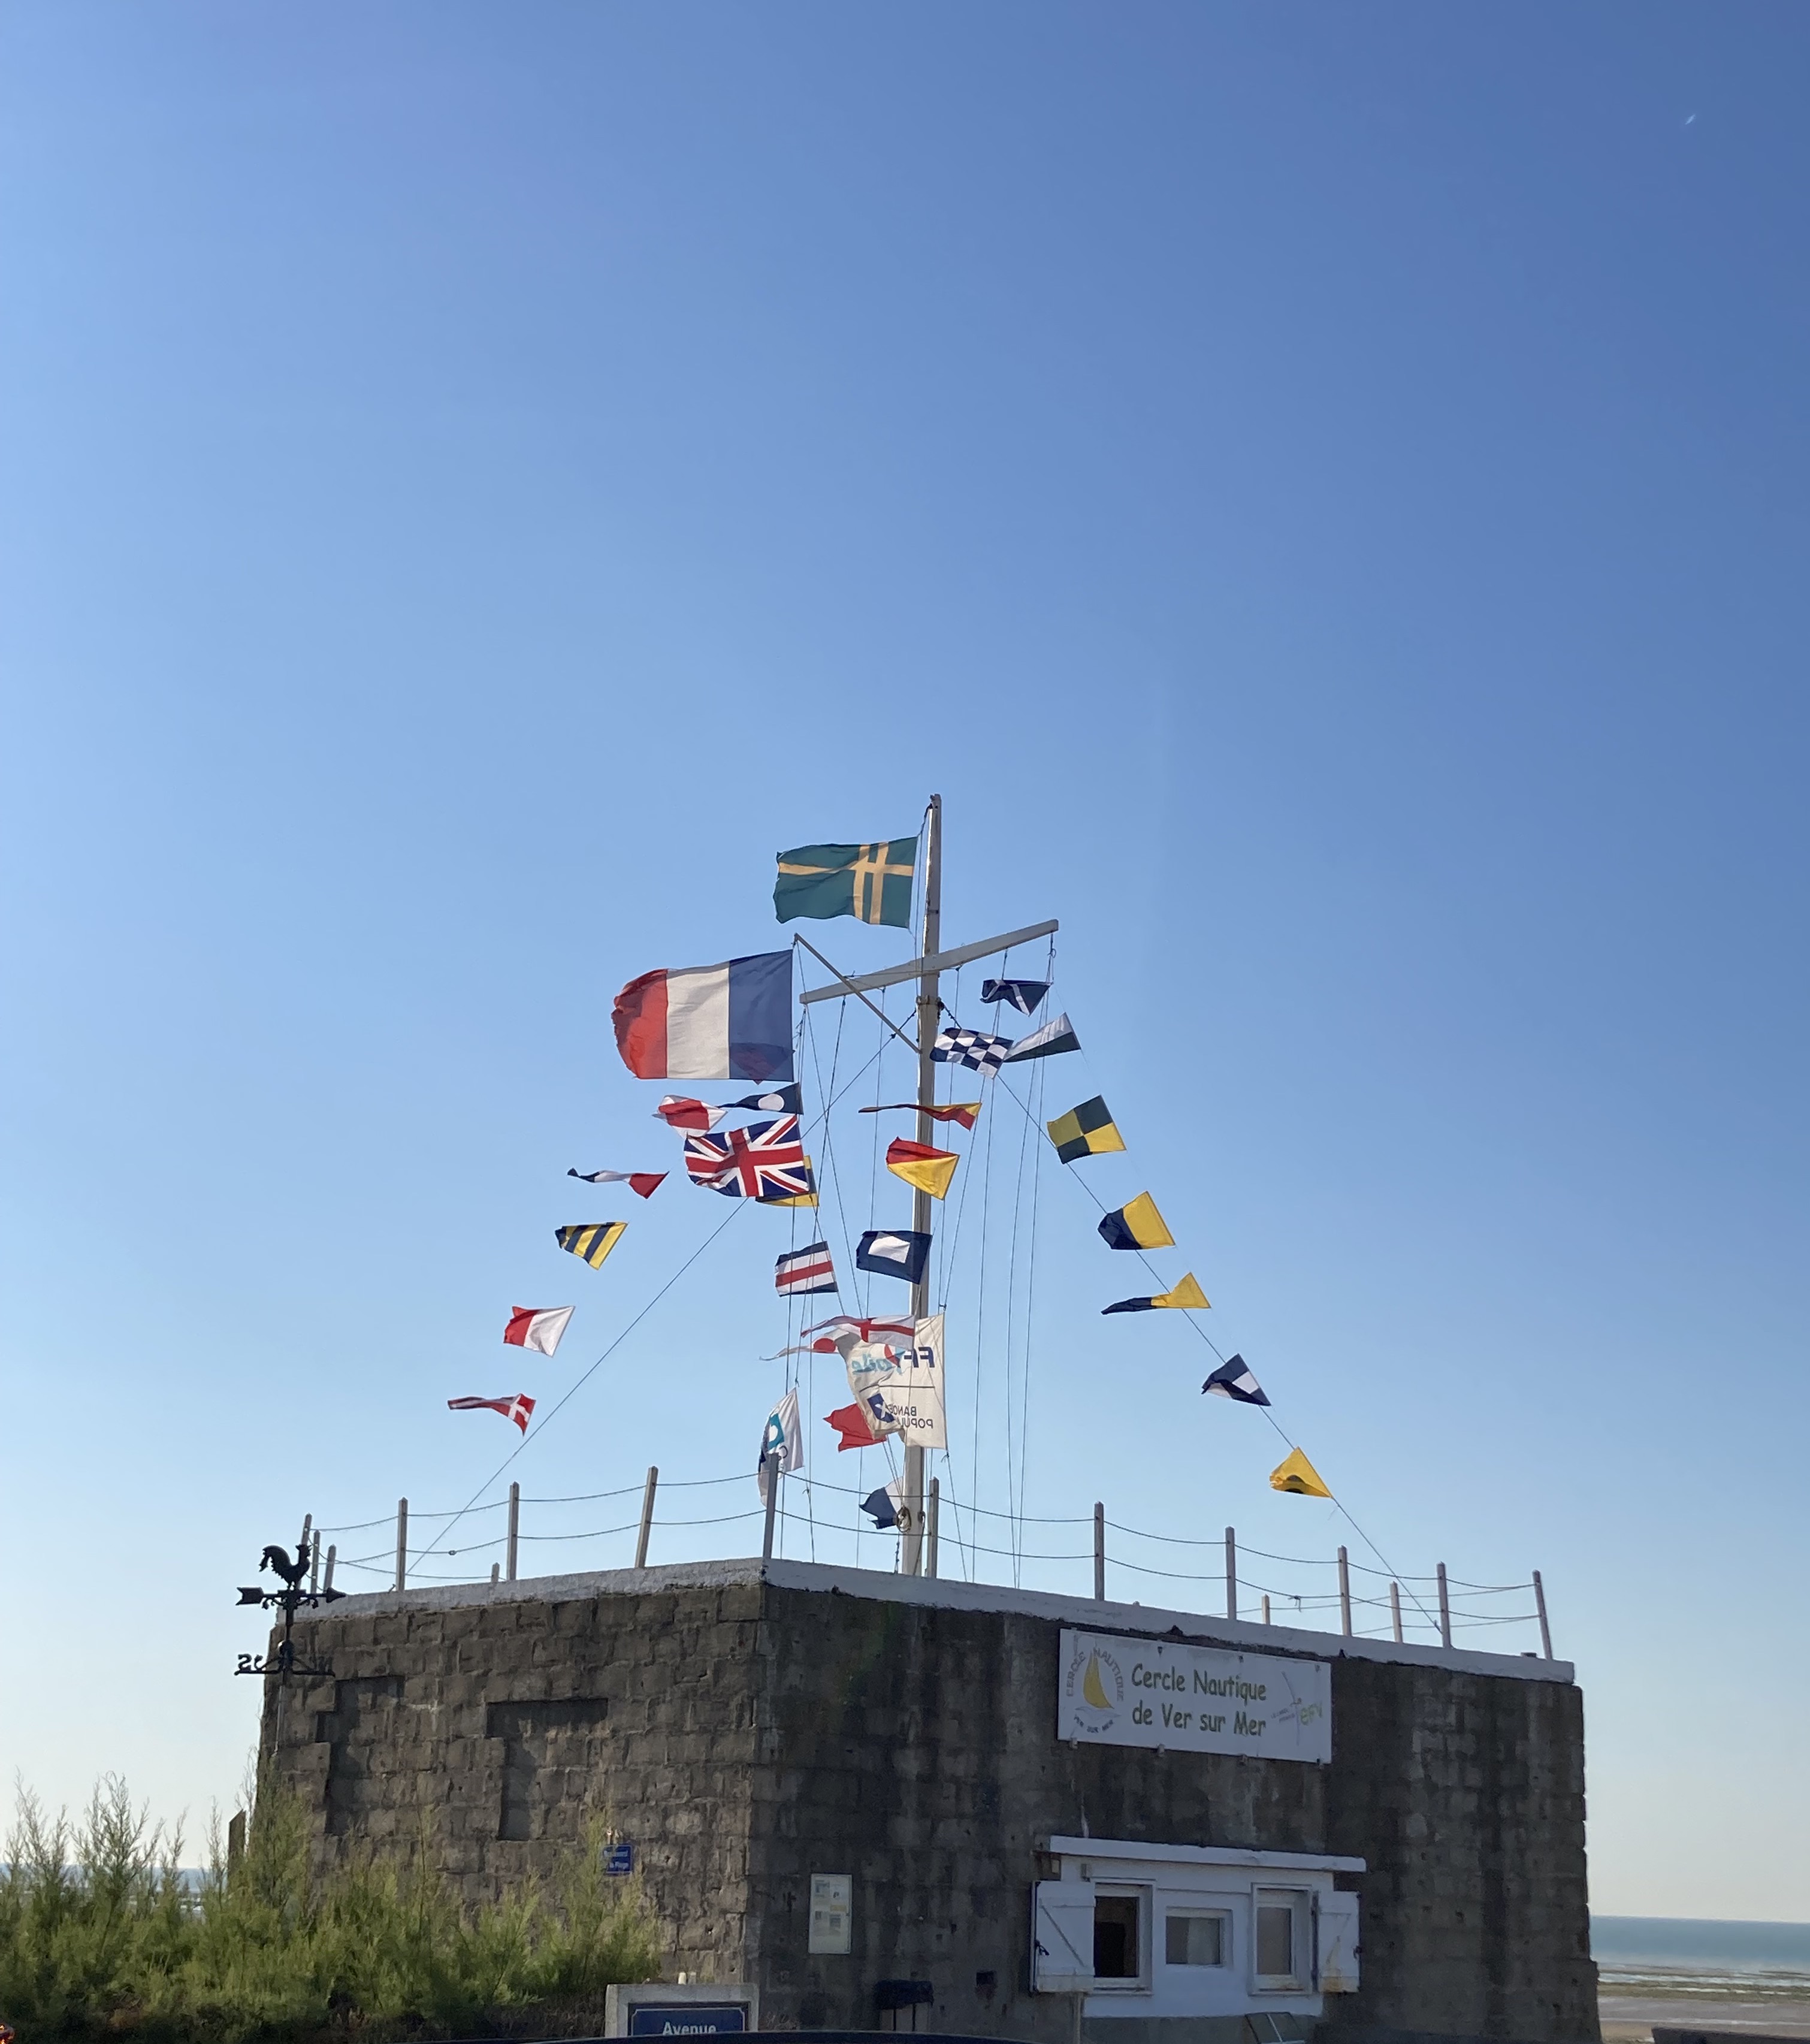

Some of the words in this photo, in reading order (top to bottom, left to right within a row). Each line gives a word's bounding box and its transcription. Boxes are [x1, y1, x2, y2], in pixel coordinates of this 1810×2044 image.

[1132, 1663, 1186, 1692] Cercle
[1193, 1669, 1267, 1707] Nautique
[1132, 1699, 1153, 1725] de
[1161, 1702, 1193, 1729] Ver
[1199, 1713, 1226, 1732] sur
[1233, 1710, 1267, 1737] Mer
[663, 2021, 717, 2036] Avenue
